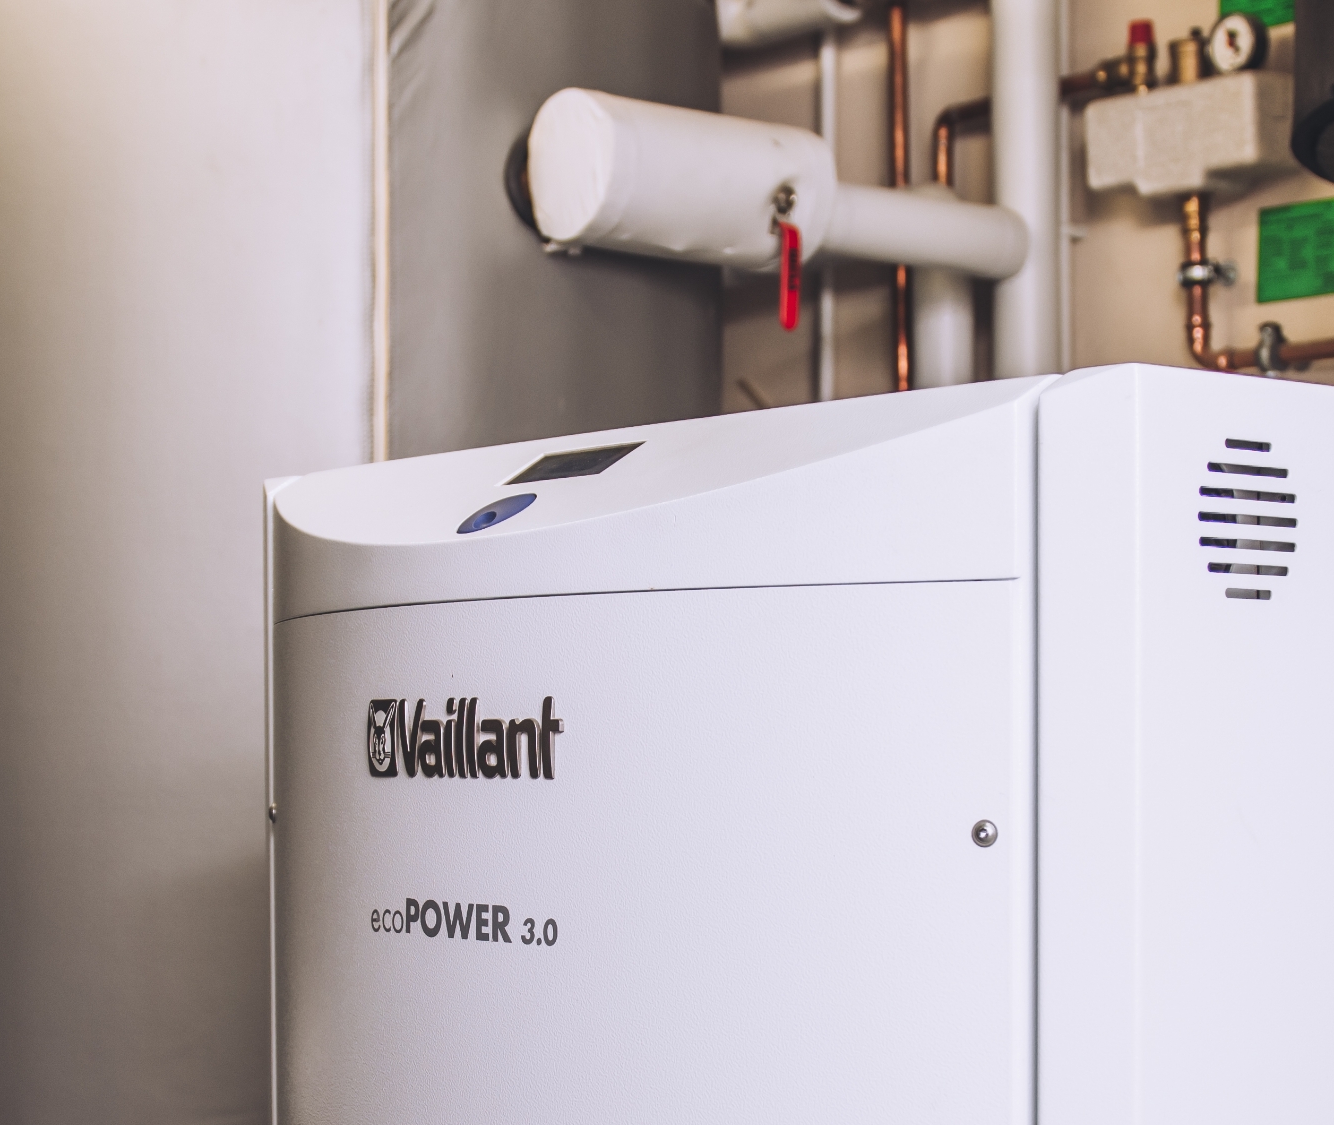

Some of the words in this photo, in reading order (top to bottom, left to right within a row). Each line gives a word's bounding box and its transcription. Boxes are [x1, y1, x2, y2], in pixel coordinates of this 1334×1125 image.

[399, 696, 564, 779] Vaillant
[371, 898, 512, 943] ecoPOWER
[521, 917, 558, 946] 3.0
